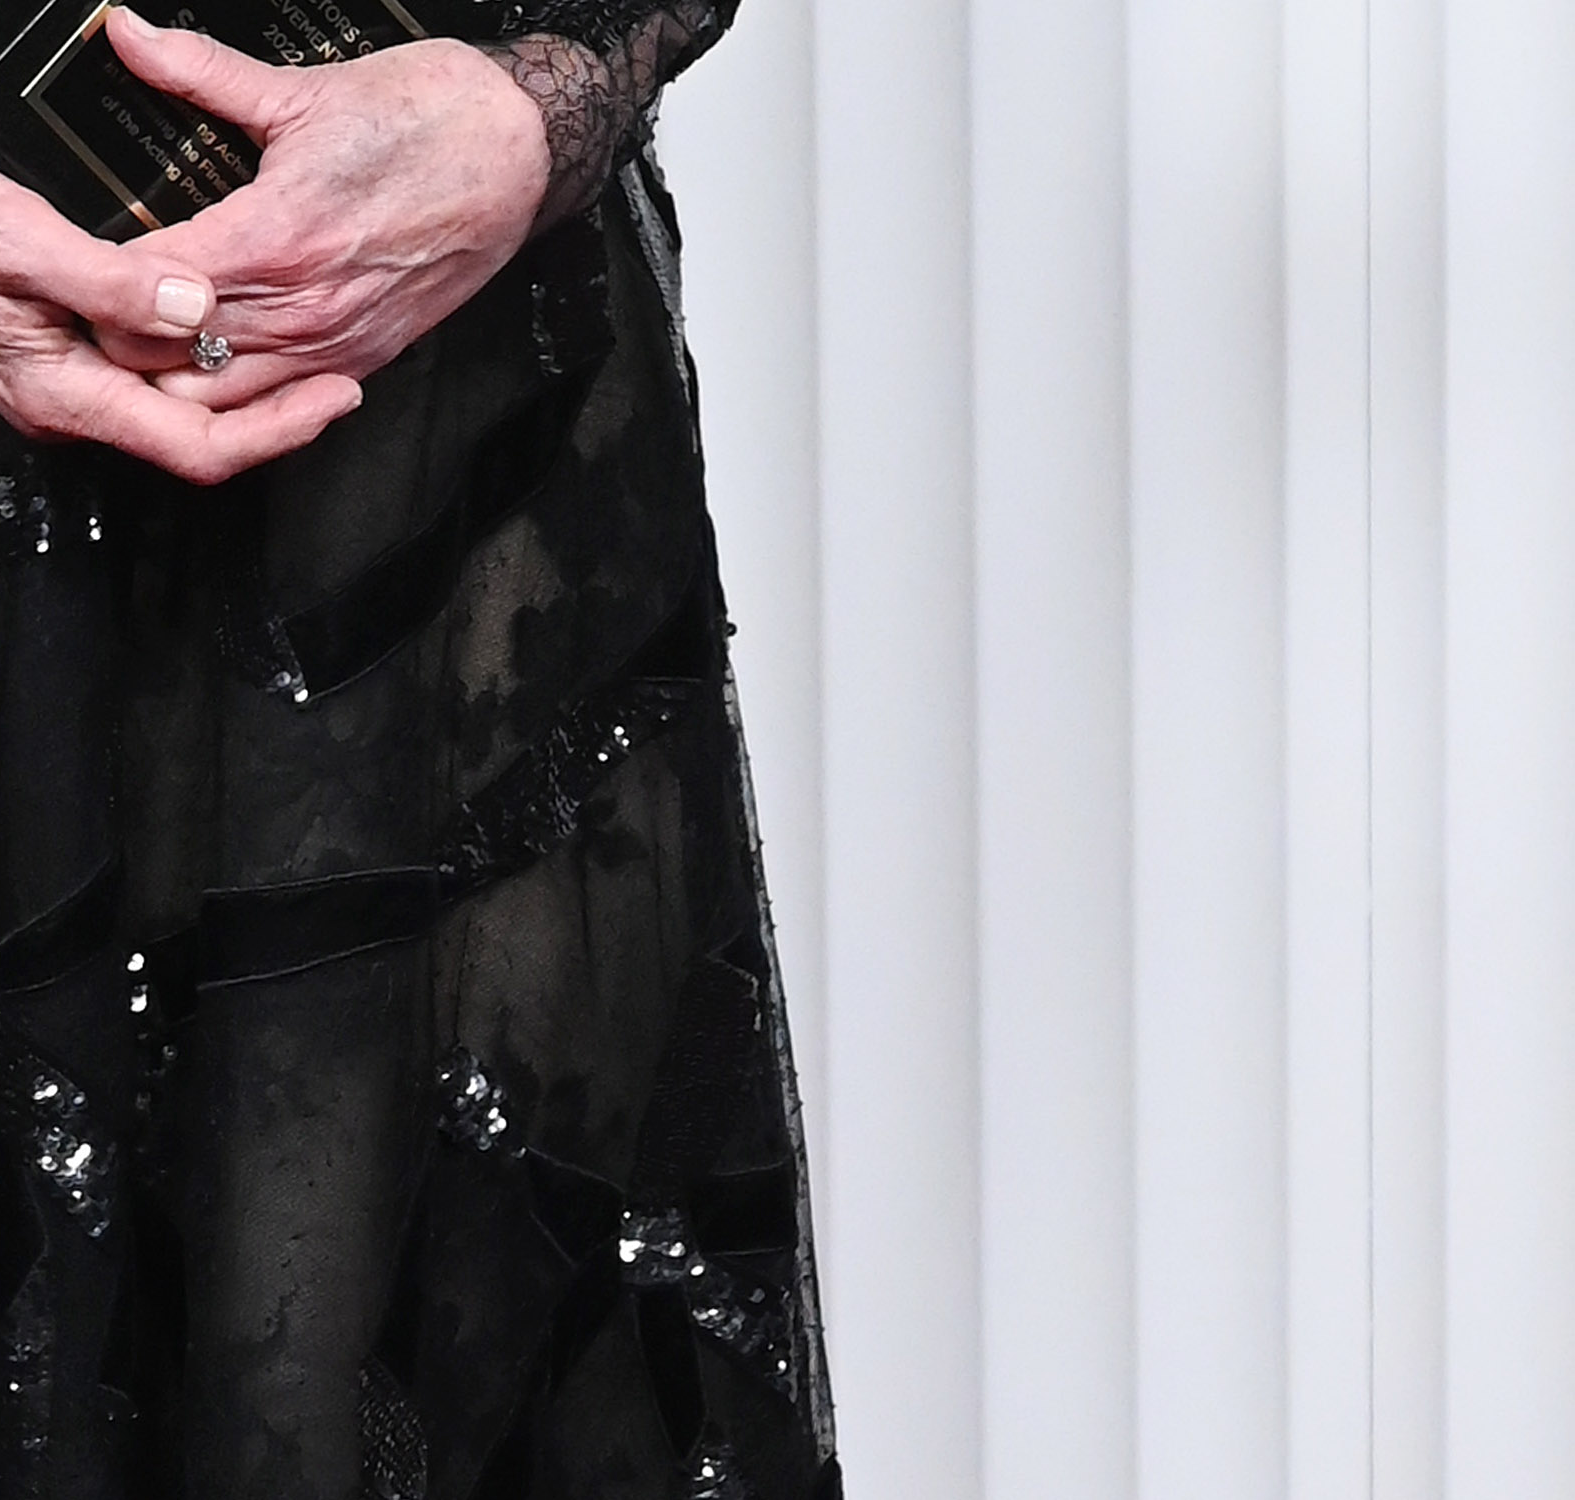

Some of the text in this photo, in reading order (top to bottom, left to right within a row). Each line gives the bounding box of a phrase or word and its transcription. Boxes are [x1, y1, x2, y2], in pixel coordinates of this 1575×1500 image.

[262, 23, 305, 65] 2022
[100, 94, 121, 113] of
[116, 108, 140, 137] the
[138, 132, 182, 183] Acting
[176, 137, 201, 165] the
